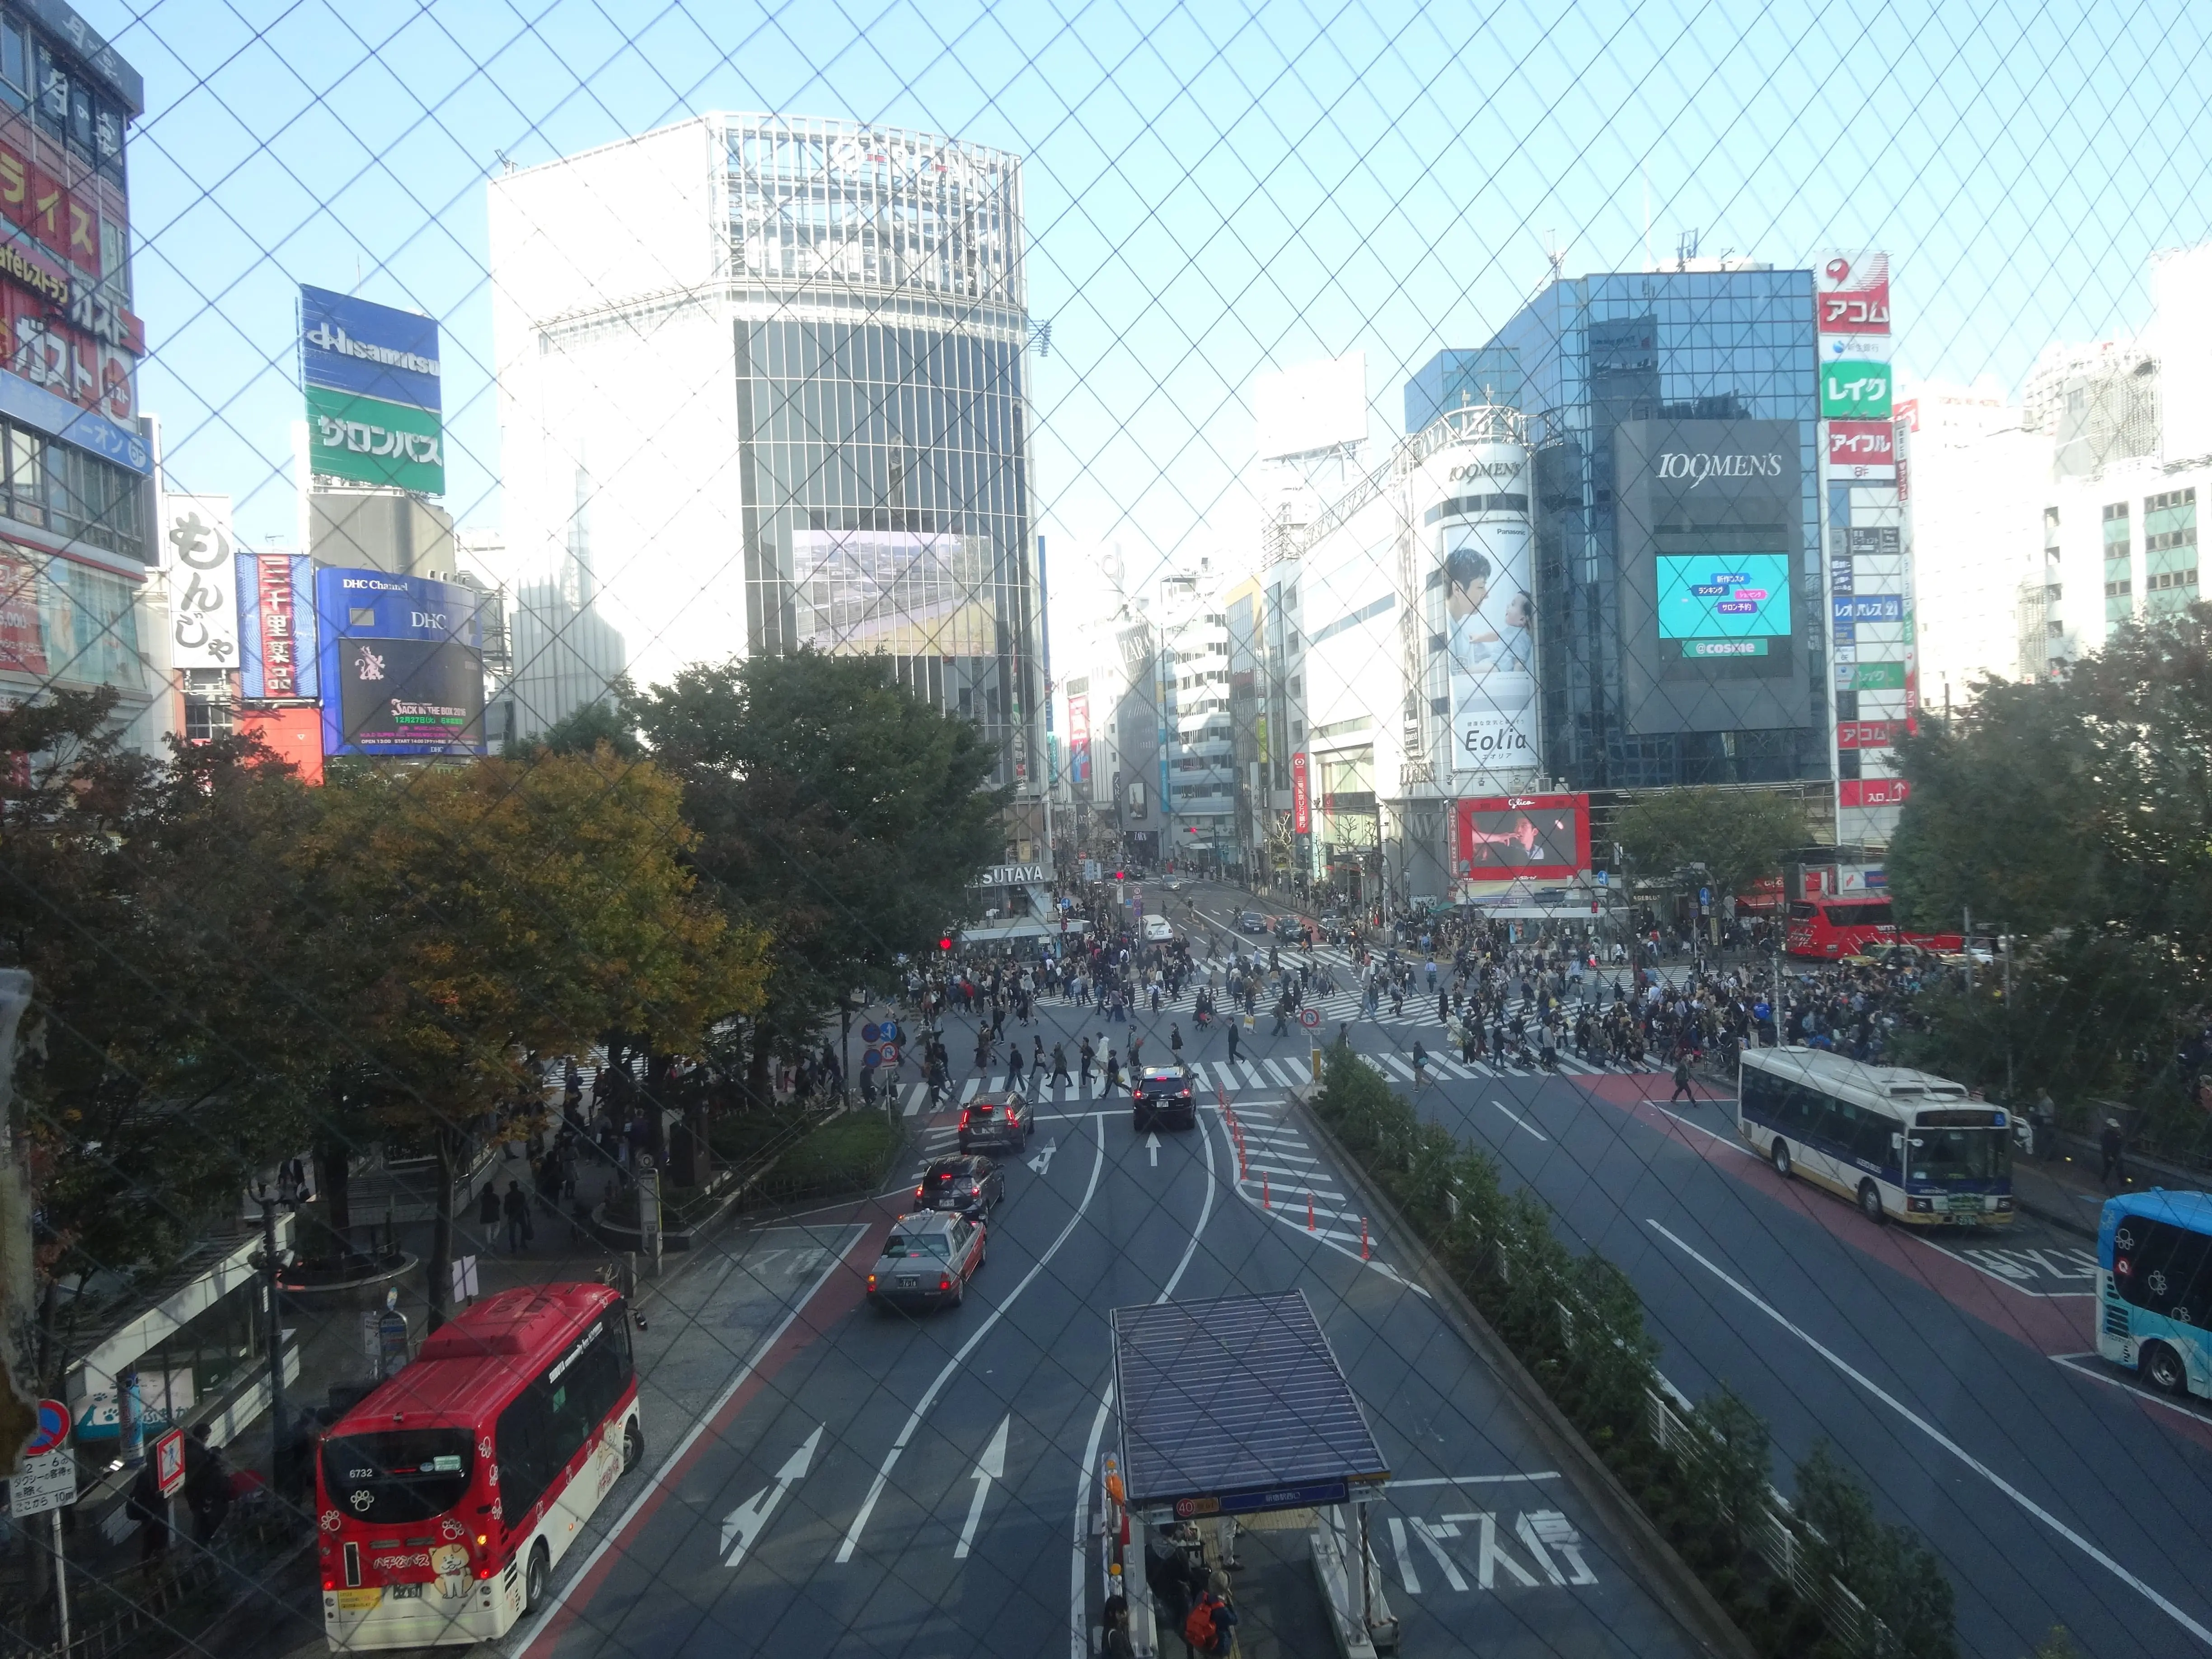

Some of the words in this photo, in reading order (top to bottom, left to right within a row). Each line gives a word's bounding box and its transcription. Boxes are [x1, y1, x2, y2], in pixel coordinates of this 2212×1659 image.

[71, 277, 130, 348] ガスト
[1826, 300, 1890, 323] アコム
[15, 315, 92, 399] ガスト
[306, 322, 441, 376] Hisamitsu
[1828, 377, 1887, 401] レイク
[318, 414, 442, 466] サロンパス
[1831, 434, 1891, 452] アイフル
[1655, 452, 1782, 489] 109MEN'S
[1497, 528, 1526, 536] Panasonic
[169, 511, 234, 663] もんじゃ
[343, 579, 368, 589] DHC
[369, 581, 408, 591] Channel
[1698, 586, 1724, 595] ランキング
[1722, 603, 1752, 612] サロン予約
[411, 611, 447, 630] DHC
[1120, 634, 1150, 663] ZARA
[1695, 642, 1755, 655] @cosme
[391, 698, 417, 716] JACK
[428, 706, 440, 715] THE
[441, 707, 453, 716] BOX
[454, 708, 466, 717] 2016
[1465, 728, 1527, 751] Eolia
[1843, 727, 1887, 741] アコム
[1869, 793, 1885, 802] 入口
[1134, 831, 1147, 841] ZARA
[982, 866, 1043, 884] SUTAYA
[349, 1468, 373, 1478] 6732
[15, 1496, 48, 1513] ここから
[54, 1491, 74, 1503] 10m
[1178, 1501, 1193, 1513] 40
